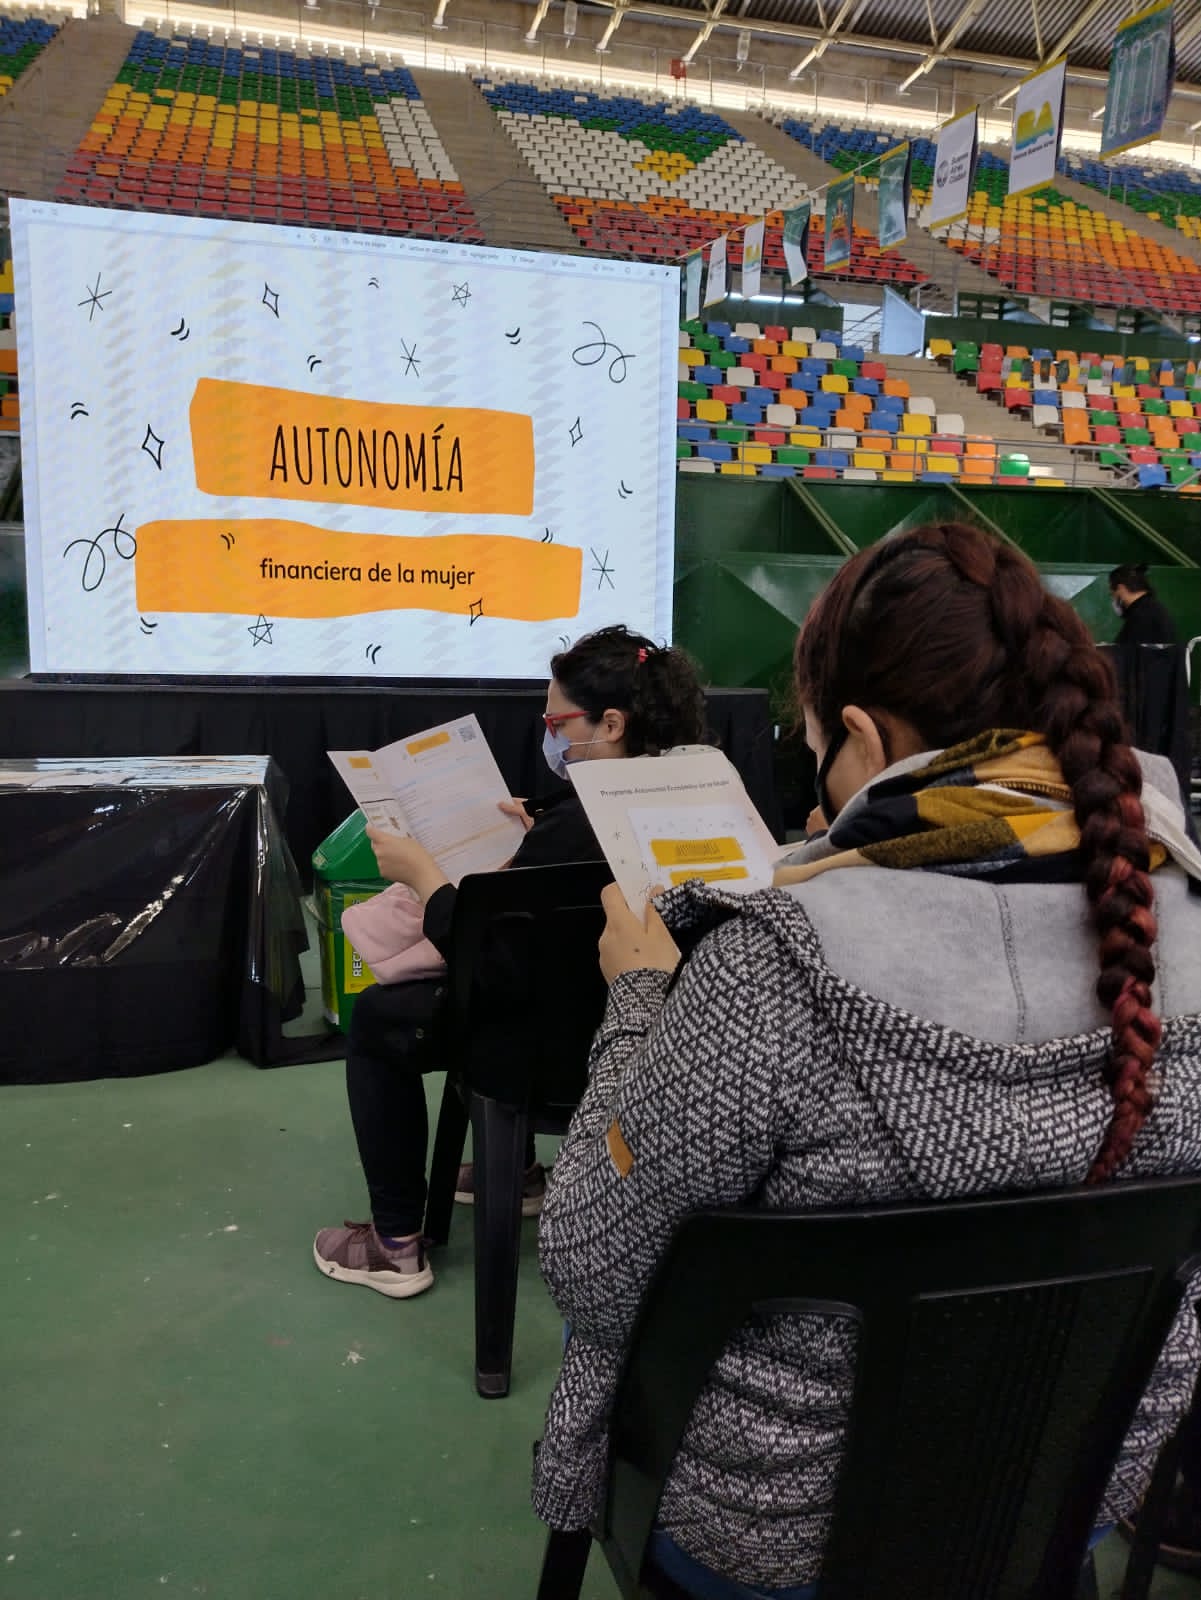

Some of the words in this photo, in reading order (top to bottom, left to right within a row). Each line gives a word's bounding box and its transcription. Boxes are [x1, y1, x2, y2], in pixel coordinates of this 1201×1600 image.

[270, 424, 463, 493] AUTONOMÍA
[259, 558, 361, 581] financiera
[368, 562, 392, 582] de
[398, 562, 415, 583] la
[421, 565, 476, 590] mujer
[352, 951, 363, 977] REC
